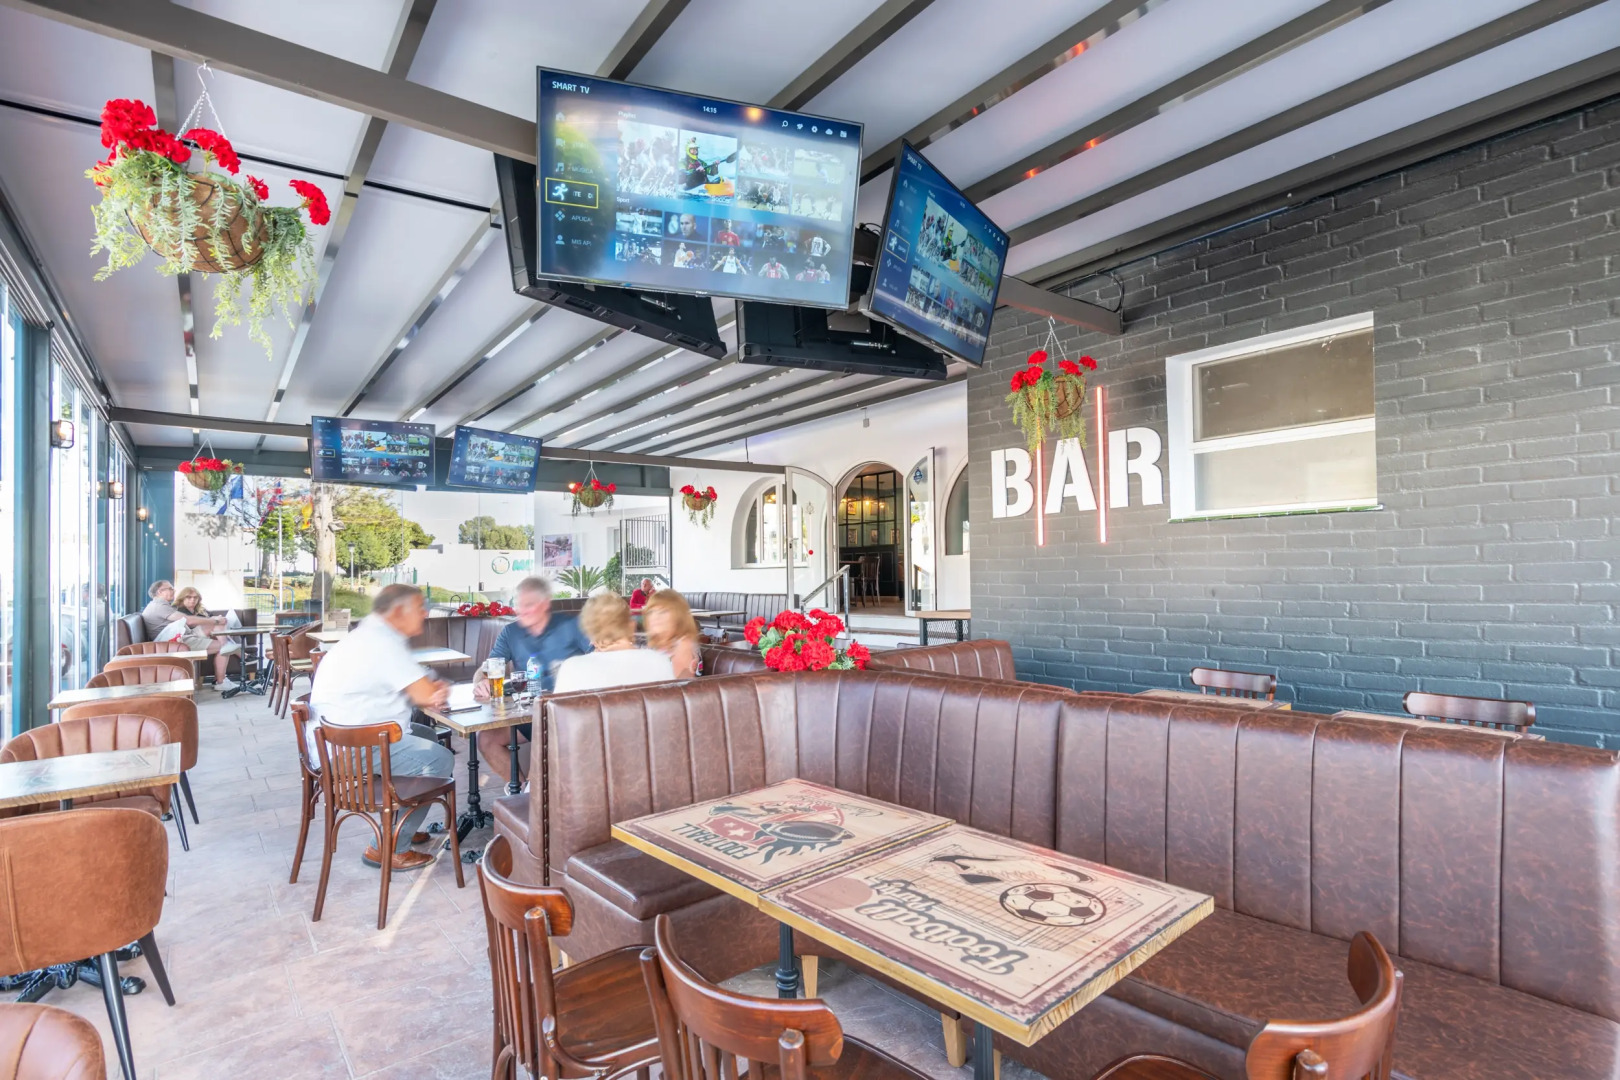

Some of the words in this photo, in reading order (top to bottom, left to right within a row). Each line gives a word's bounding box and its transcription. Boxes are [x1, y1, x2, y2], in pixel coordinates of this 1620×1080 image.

[552, 81, 577, 92] SMART
[580, 85, 590, 94] TV
[703, 105, 717, 114] 14:15
[990, 426, 1164, 519] BAR
[671, 823, 760, 860] FOOTBALL
[870, 879, 940, 912] Party
[854, 898, 1029, 975] Football
